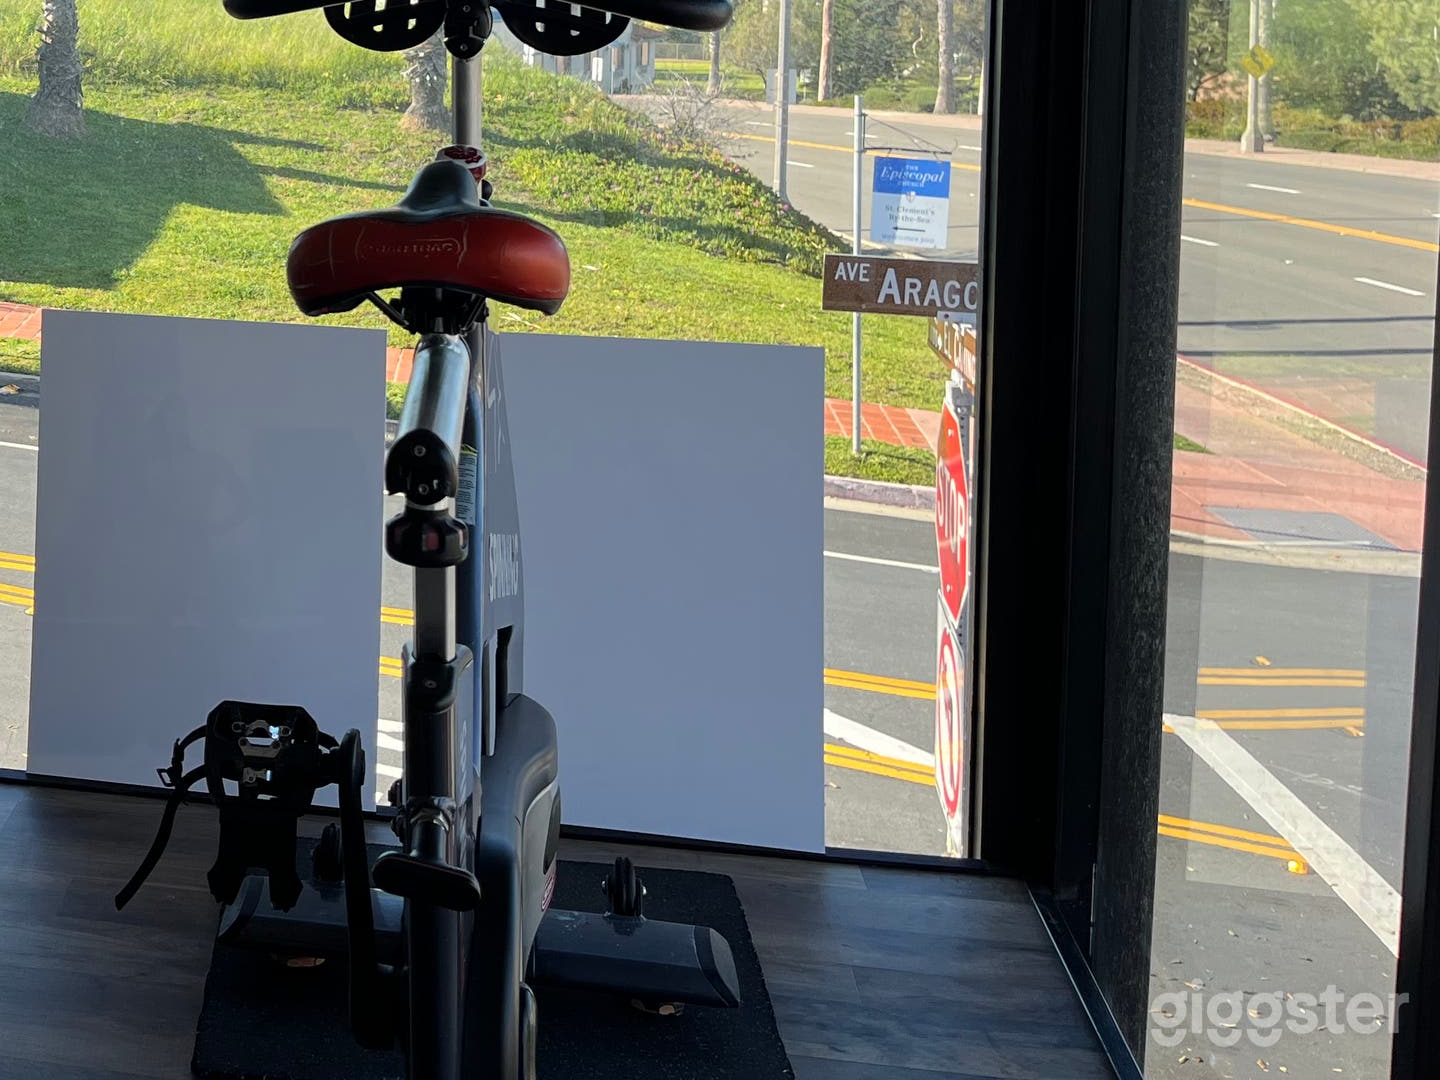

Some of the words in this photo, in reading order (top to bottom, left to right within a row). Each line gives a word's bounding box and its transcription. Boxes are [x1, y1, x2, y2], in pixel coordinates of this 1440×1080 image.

[880, 166, 945, 184] Episcopal
[834, 261, 870, 283] AVE
[936, 456, 966, 564] STOP
